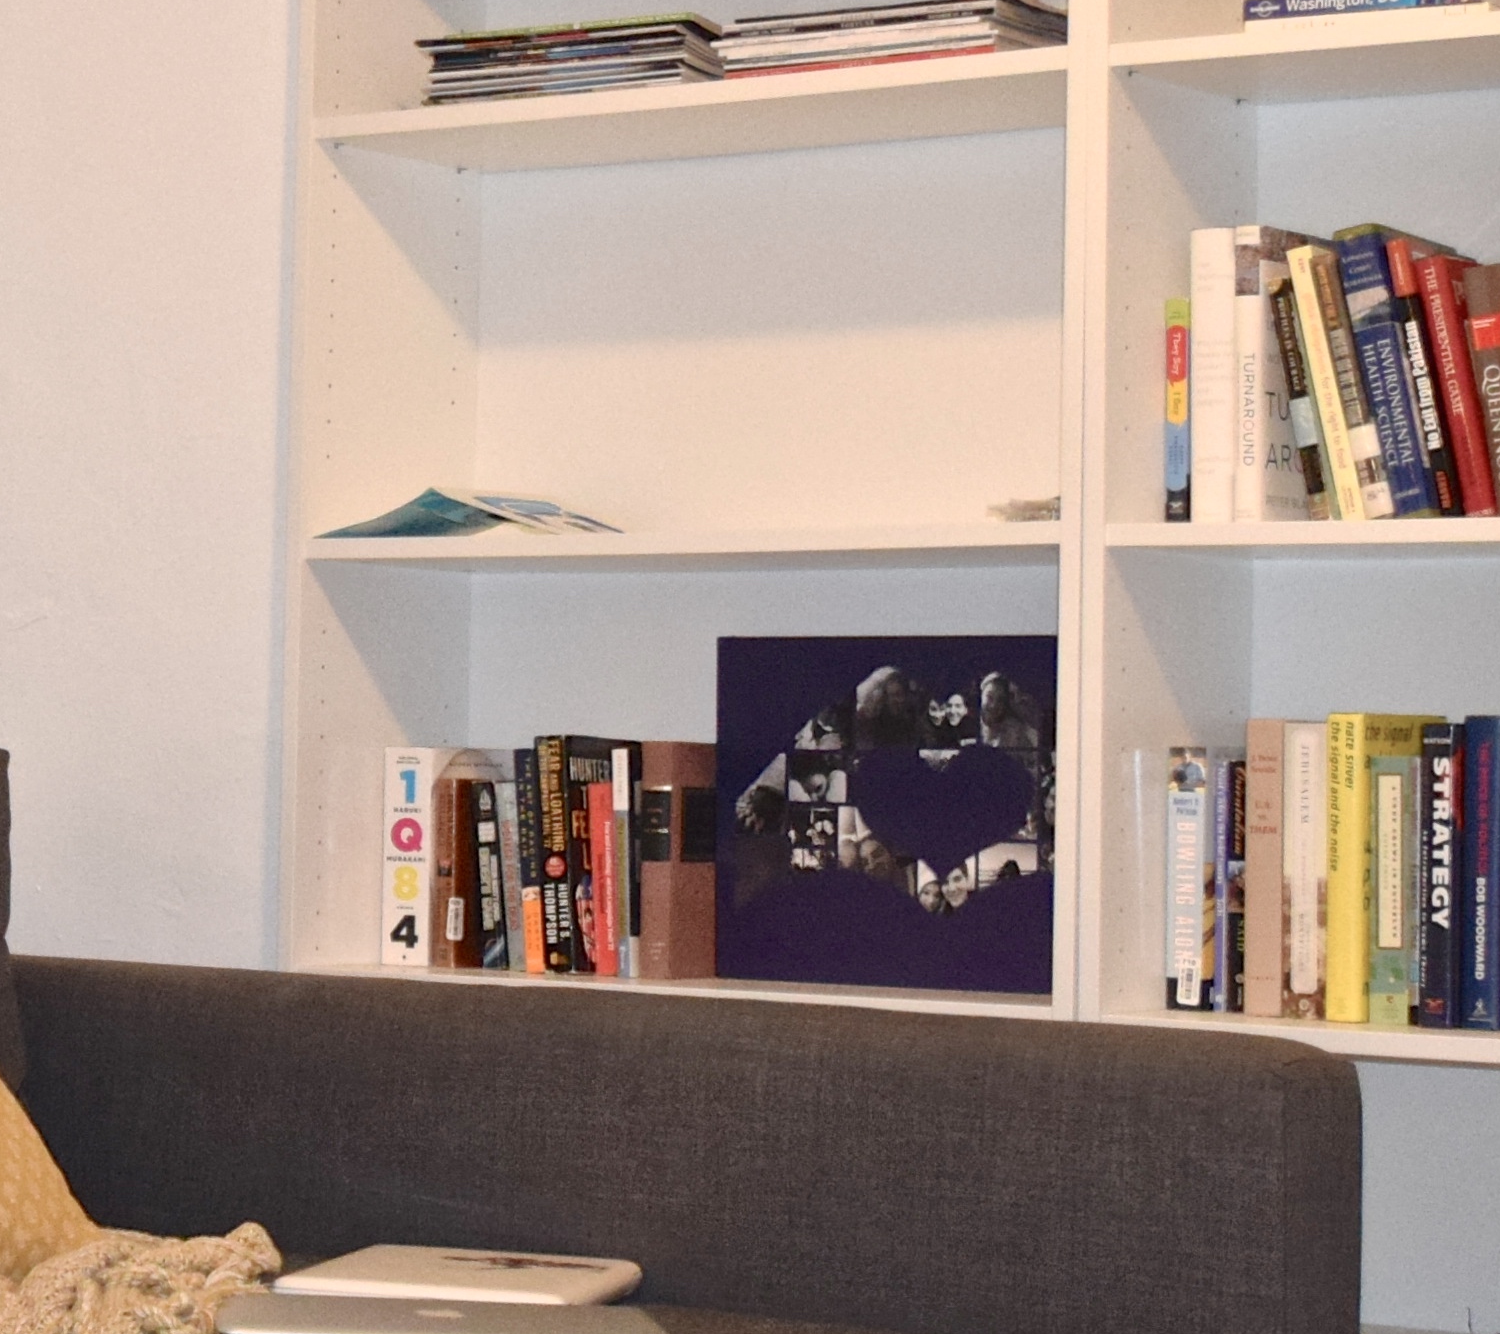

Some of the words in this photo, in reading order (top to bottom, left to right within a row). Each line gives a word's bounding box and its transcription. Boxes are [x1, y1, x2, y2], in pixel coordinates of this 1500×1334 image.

[1424, 266, 1437, 292] THE
[1405, 320, 1427, 376] Pakistan
[1430, 294, 1456, 376] PRESIDENTIAL
[1242, 353, 1256, 467] TURNAROUND
[1361, 344, 1384, 403] HEALTH
[1376, 406, 1398, 468] SCIENCE
[1378, 338, 1415, 467] ENVIRONMENTAL
[1447, 379, 1464, 417] GAME
[1426, 433, 1442, 451] No
[1329, 721, 1341, 743] the
[1344, 720, 1356, 751] nate
[548, 740, 562, 770] FEAR
[1327, 745, 1341, 784] signal
[1343, 753, 1356, 791] silver
[399, 770, 416, 804] 1
[1300, 743, 1310, 824] JERUSALEM
[1330, 786, 1341, 812] and
[390, 817, 423, 852] Q
[550, 792, 566, 853] LOATHING
[1330, 814, 1341, 835] the
[1329, 837, 1340, 873] noise
[1431, 756, 1450, 930] STRATEGY
[1175, 821, 1197, 905] BOWLING
[392, 865, 419, 901] 8
[1475, 877, 1486, 903] BOB
[543, 883, 558, 944] THOMPSON
[559, 883, 570, 929] HUNTER
[390, 914, 419, 949] 4
[1174, 915, 1195, 969] ALON
[1474, 904, 1486, 980] WOODWARD
